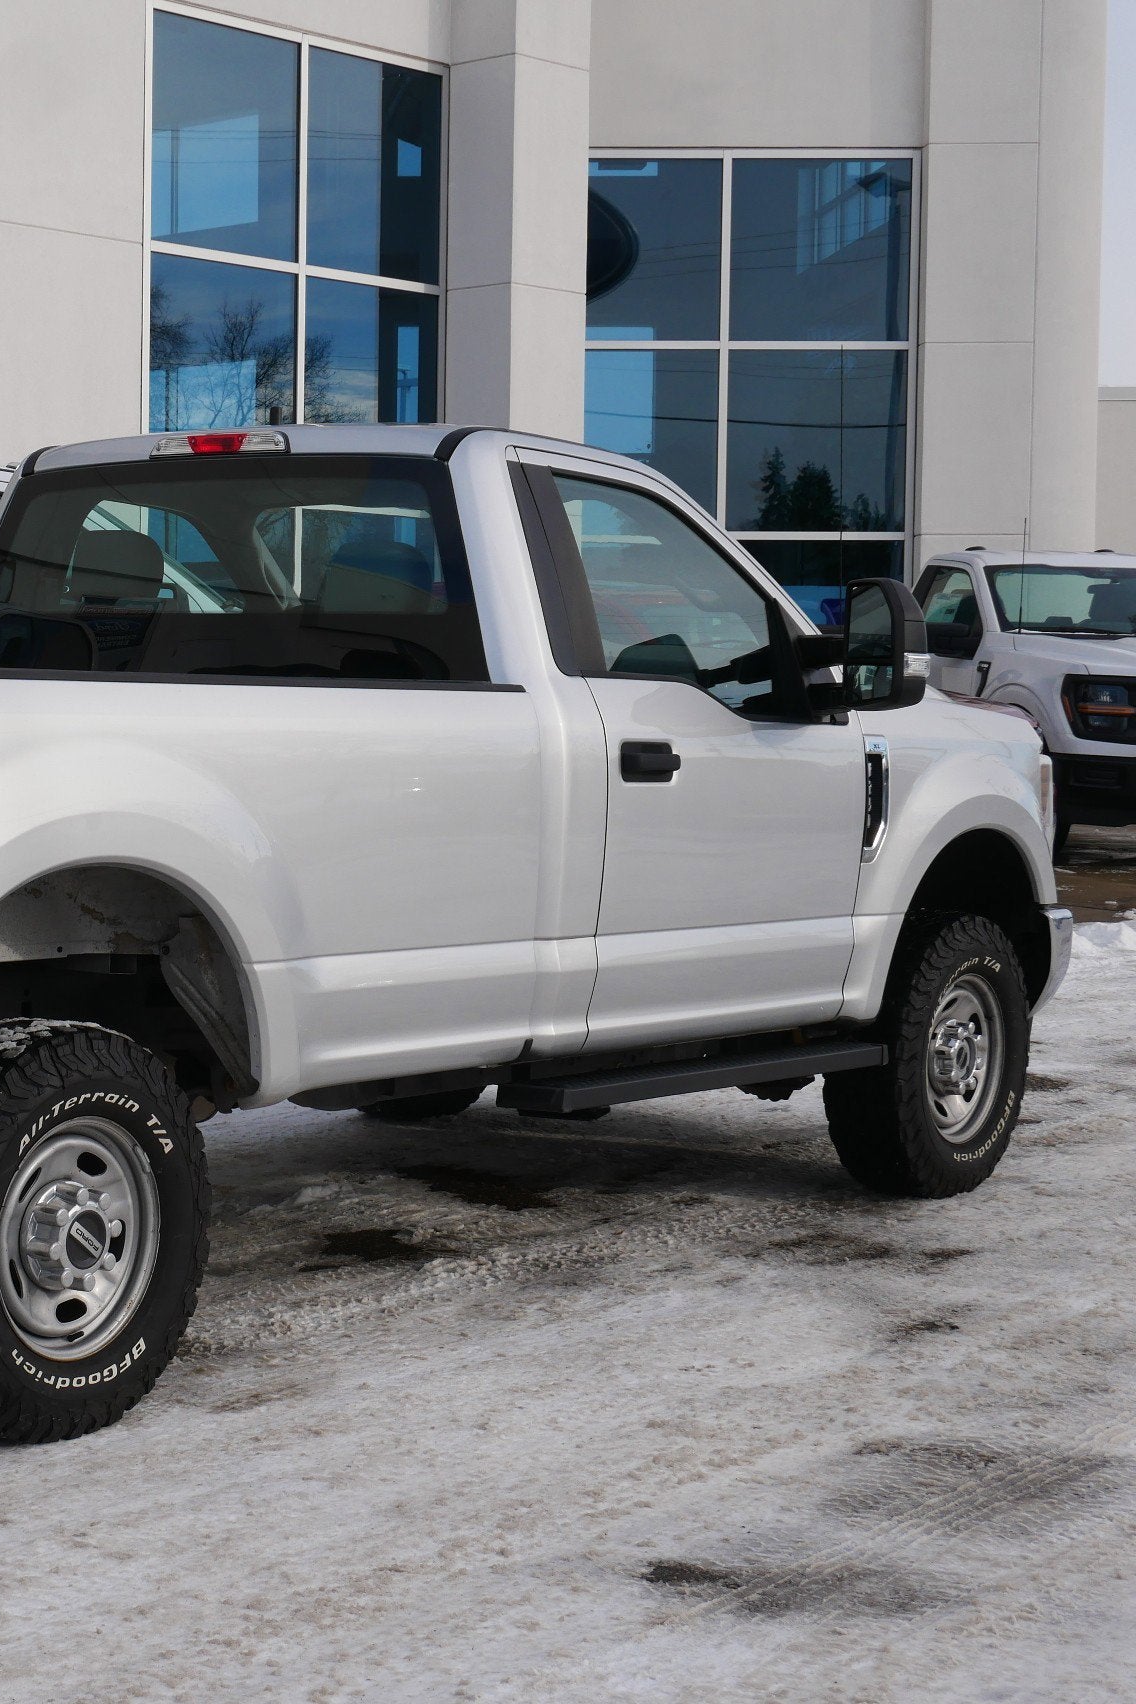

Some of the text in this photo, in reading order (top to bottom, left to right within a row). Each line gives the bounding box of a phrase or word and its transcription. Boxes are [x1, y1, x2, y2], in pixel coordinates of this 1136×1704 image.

[983, 955, 1002, 973] T/A
[18, 1092, 175, 1157] All-Terrain T/A
[953, 1090, 1015, 1162] BFGoodrich
[76, 1228, 100, 1252] FORD
[11, 1337, 147, 1391] BFGoodrich
